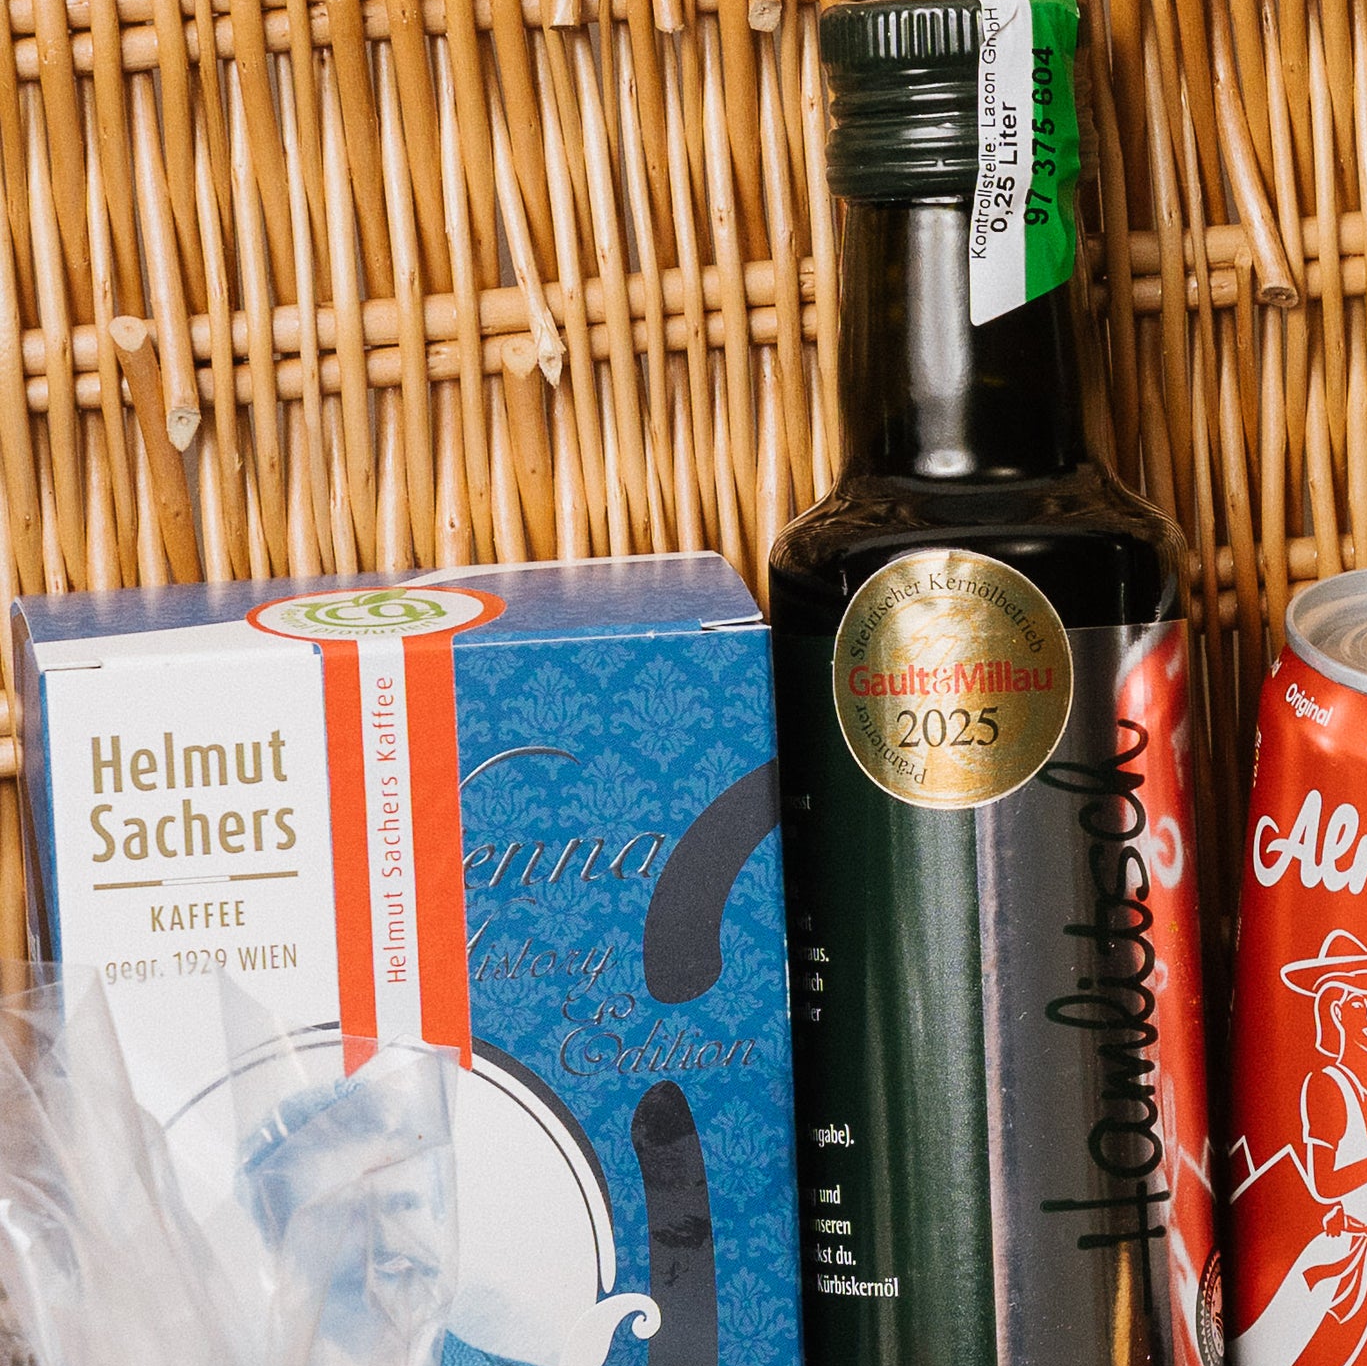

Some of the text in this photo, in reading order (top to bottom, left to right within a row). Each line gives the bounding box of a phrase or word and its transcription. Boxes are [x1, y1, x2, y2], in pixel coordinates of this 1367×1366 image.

[971, 6, 1000, 261] Kontrollstelle: Lacon GmbH
[1024, 45, 1056, 227] 97 375 604
[990, 100, 1018, 234] 0,25 Liter
[848, 660, 1054, 697] Gault&Millau
[850, 572, 1045, 785] Prämierter Steirischer Kernölbetrieb
[1284, 682, 1333, 728] Original
[896, 705, 1000, 748] 2025
[91, 729, 288, 794] Helmut
[90, 799, 297, 863] Sachers
[373, 676, 407, 984] Helmut Sachers Kaffee
[463, 831, 666, 891] enna
[150, 900, 246, 932] KAFFEE
[104, 943, 298, 985] gegr. 1929 WIEN
[558, 992, 766, 1077] Edition
[1036, 718, 1172, 1313] Hamlitsch
[819, 1184, 841, 1205] und
[817, 1273, 900, 1298] Kürbiskernöl
[835, 1244, 857, 1266] du.
